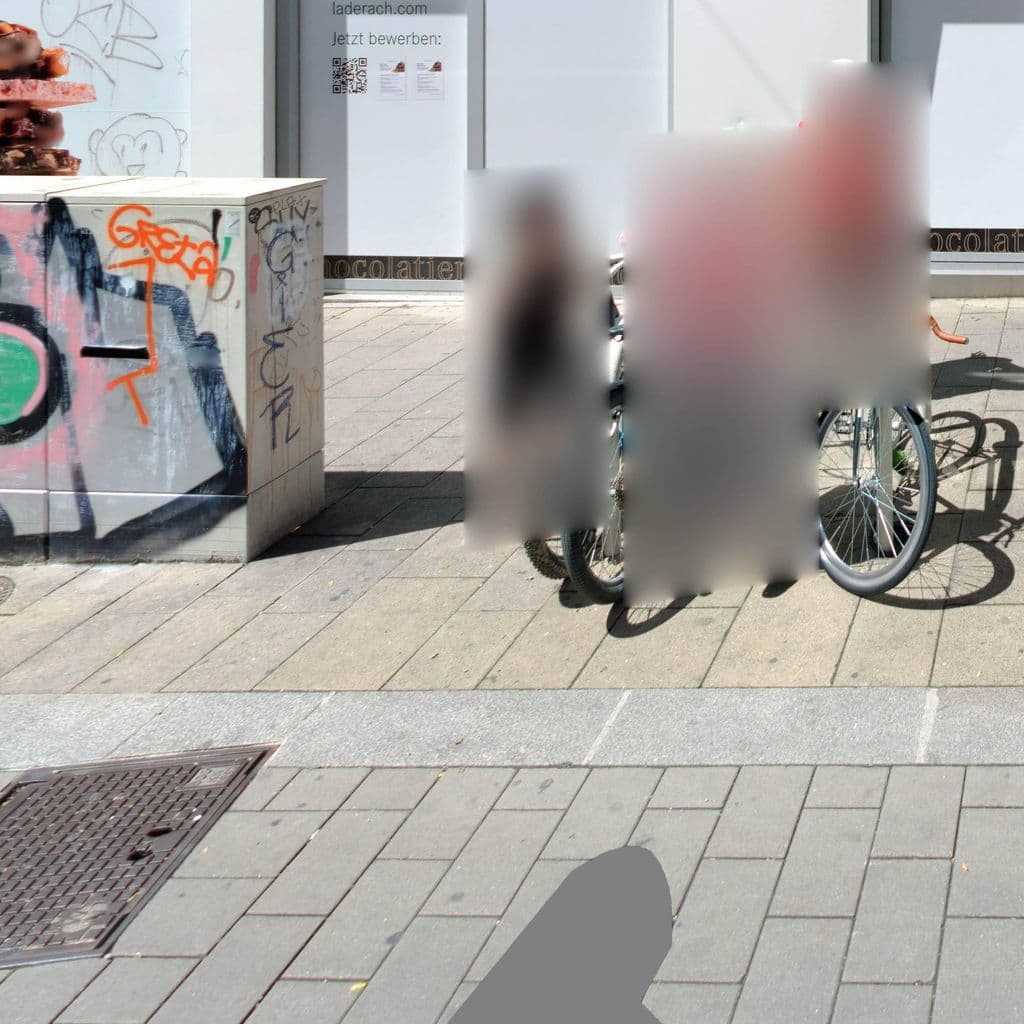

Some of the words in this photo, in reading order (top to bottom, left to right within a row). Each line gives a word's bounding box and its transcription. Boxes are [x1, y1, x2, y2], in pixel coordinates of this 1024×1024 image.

[332, 1, 428, 16] laderach.com
[332, 32, 364, 47] Jetzt
[369, 32, 442, 46] bewerben:
